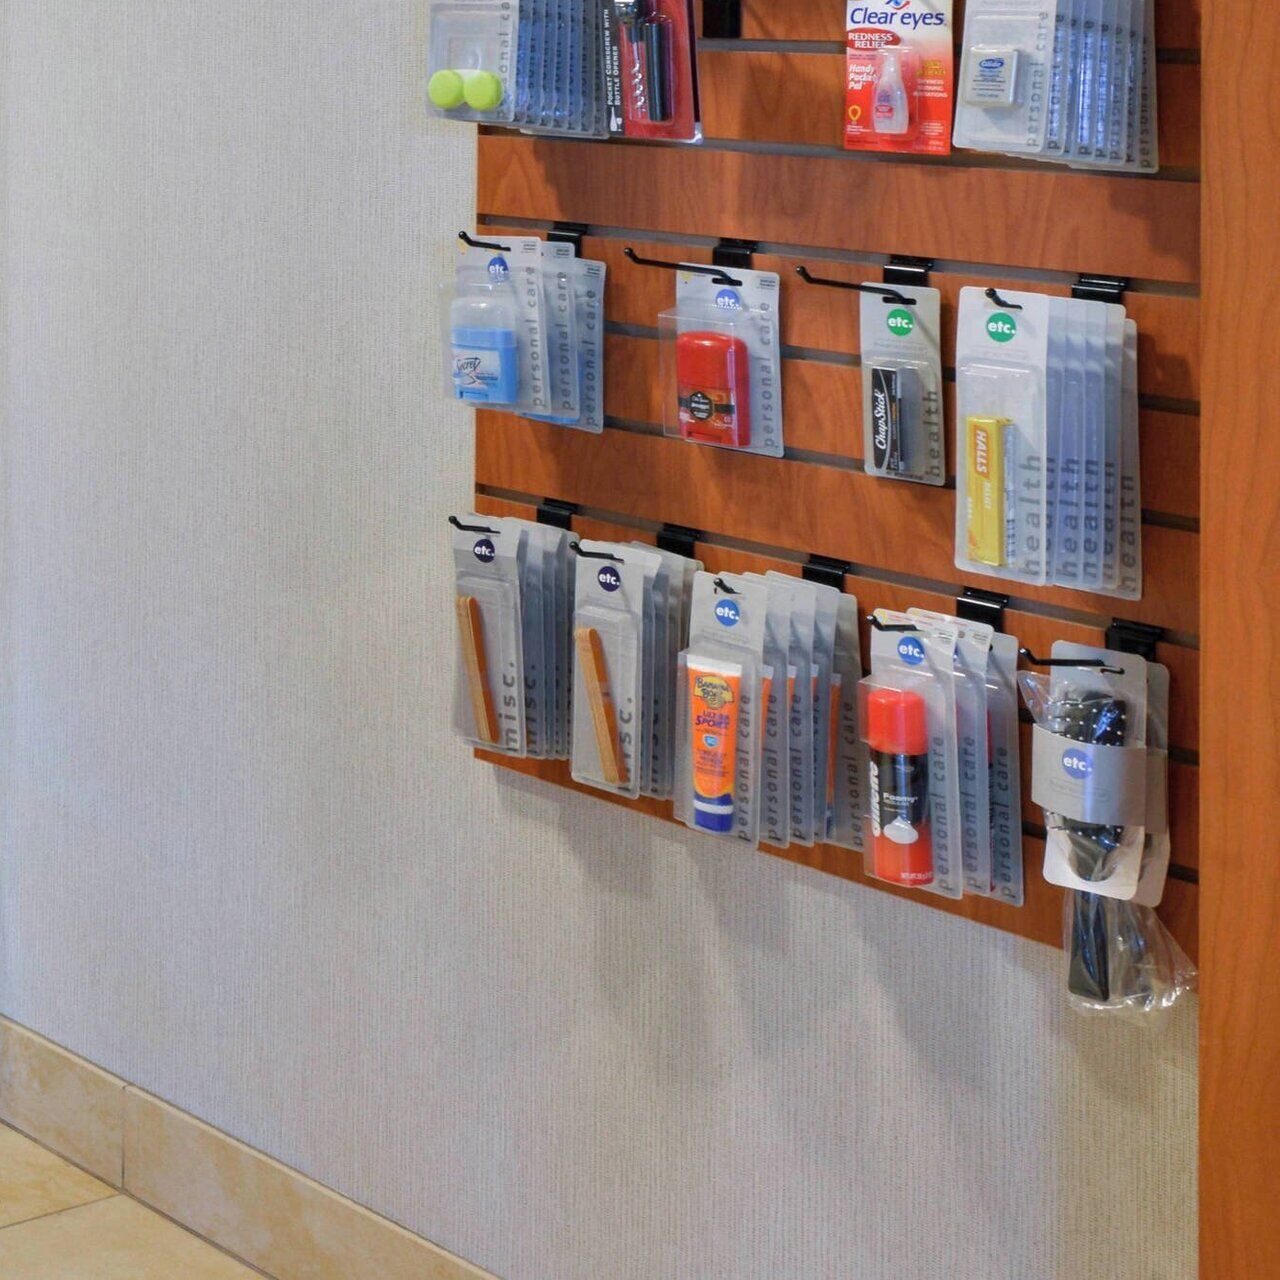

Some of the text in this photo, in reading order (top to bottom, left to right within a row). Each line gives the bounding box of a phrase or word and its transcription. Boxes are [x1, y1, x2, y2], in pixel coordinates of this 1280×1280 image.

[850, 7, 944, 30] Clear eyes
[848, 32, 893, 41] REDNESS
[526, 266, 546, 408] personal care
[887, 316, 914, 329] etc.
[988, 321, 1016, 335] etc.
[560, 322, 575, 411] personal
[759, 302, 776, 448] personal care
[874, 388, 887, 451] ChapStick
[922, 389, 939, 478] health
[975, 429, 988, 474] HALLS
[1019, 454, 1042, 577] health
[474, 545, 495, 558] etc.
[598, 572, 621, 586] etc.
[715, 604, 740, 620] etc.
[898, 642, 925, 659] etc.
[498, 662, 519, 751] misc.
[1063, 756, 1093, 773] etc.
[932, 736, 955, 892] personal care
